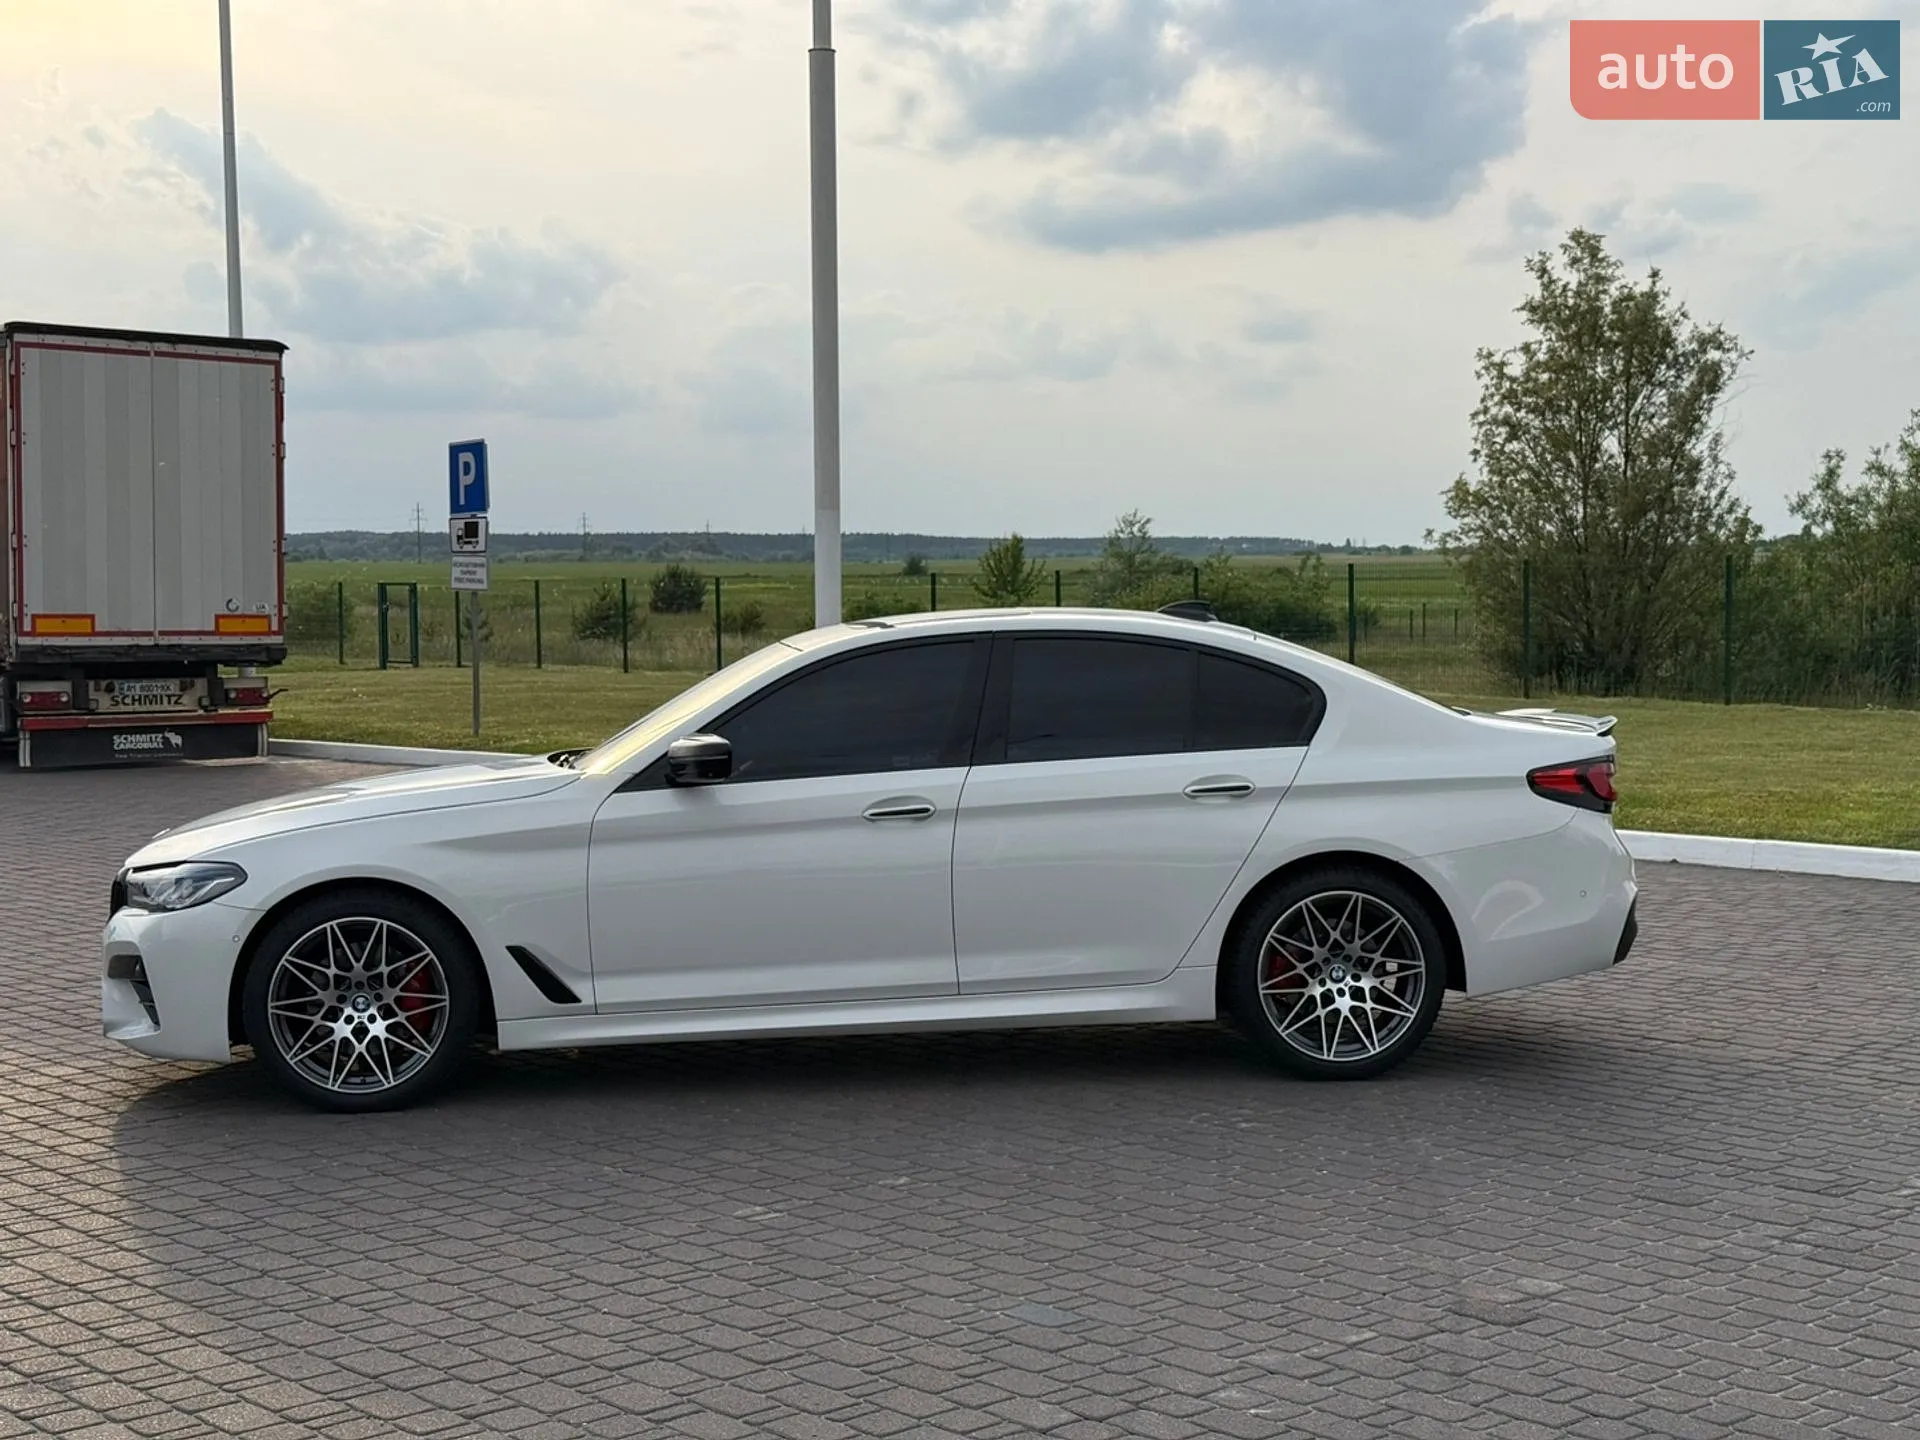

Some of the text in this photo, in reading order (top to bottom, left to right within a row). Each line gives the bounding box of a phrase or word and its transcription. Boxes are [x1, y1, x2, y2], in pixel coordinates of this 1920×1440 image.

[458, 452, 476, 505] P
[110, 693, 183, 706] SCHMITZ
[112, 733, 163, 743] SCHMITZ
[113, 742, 164, 751] CARGOBULL
